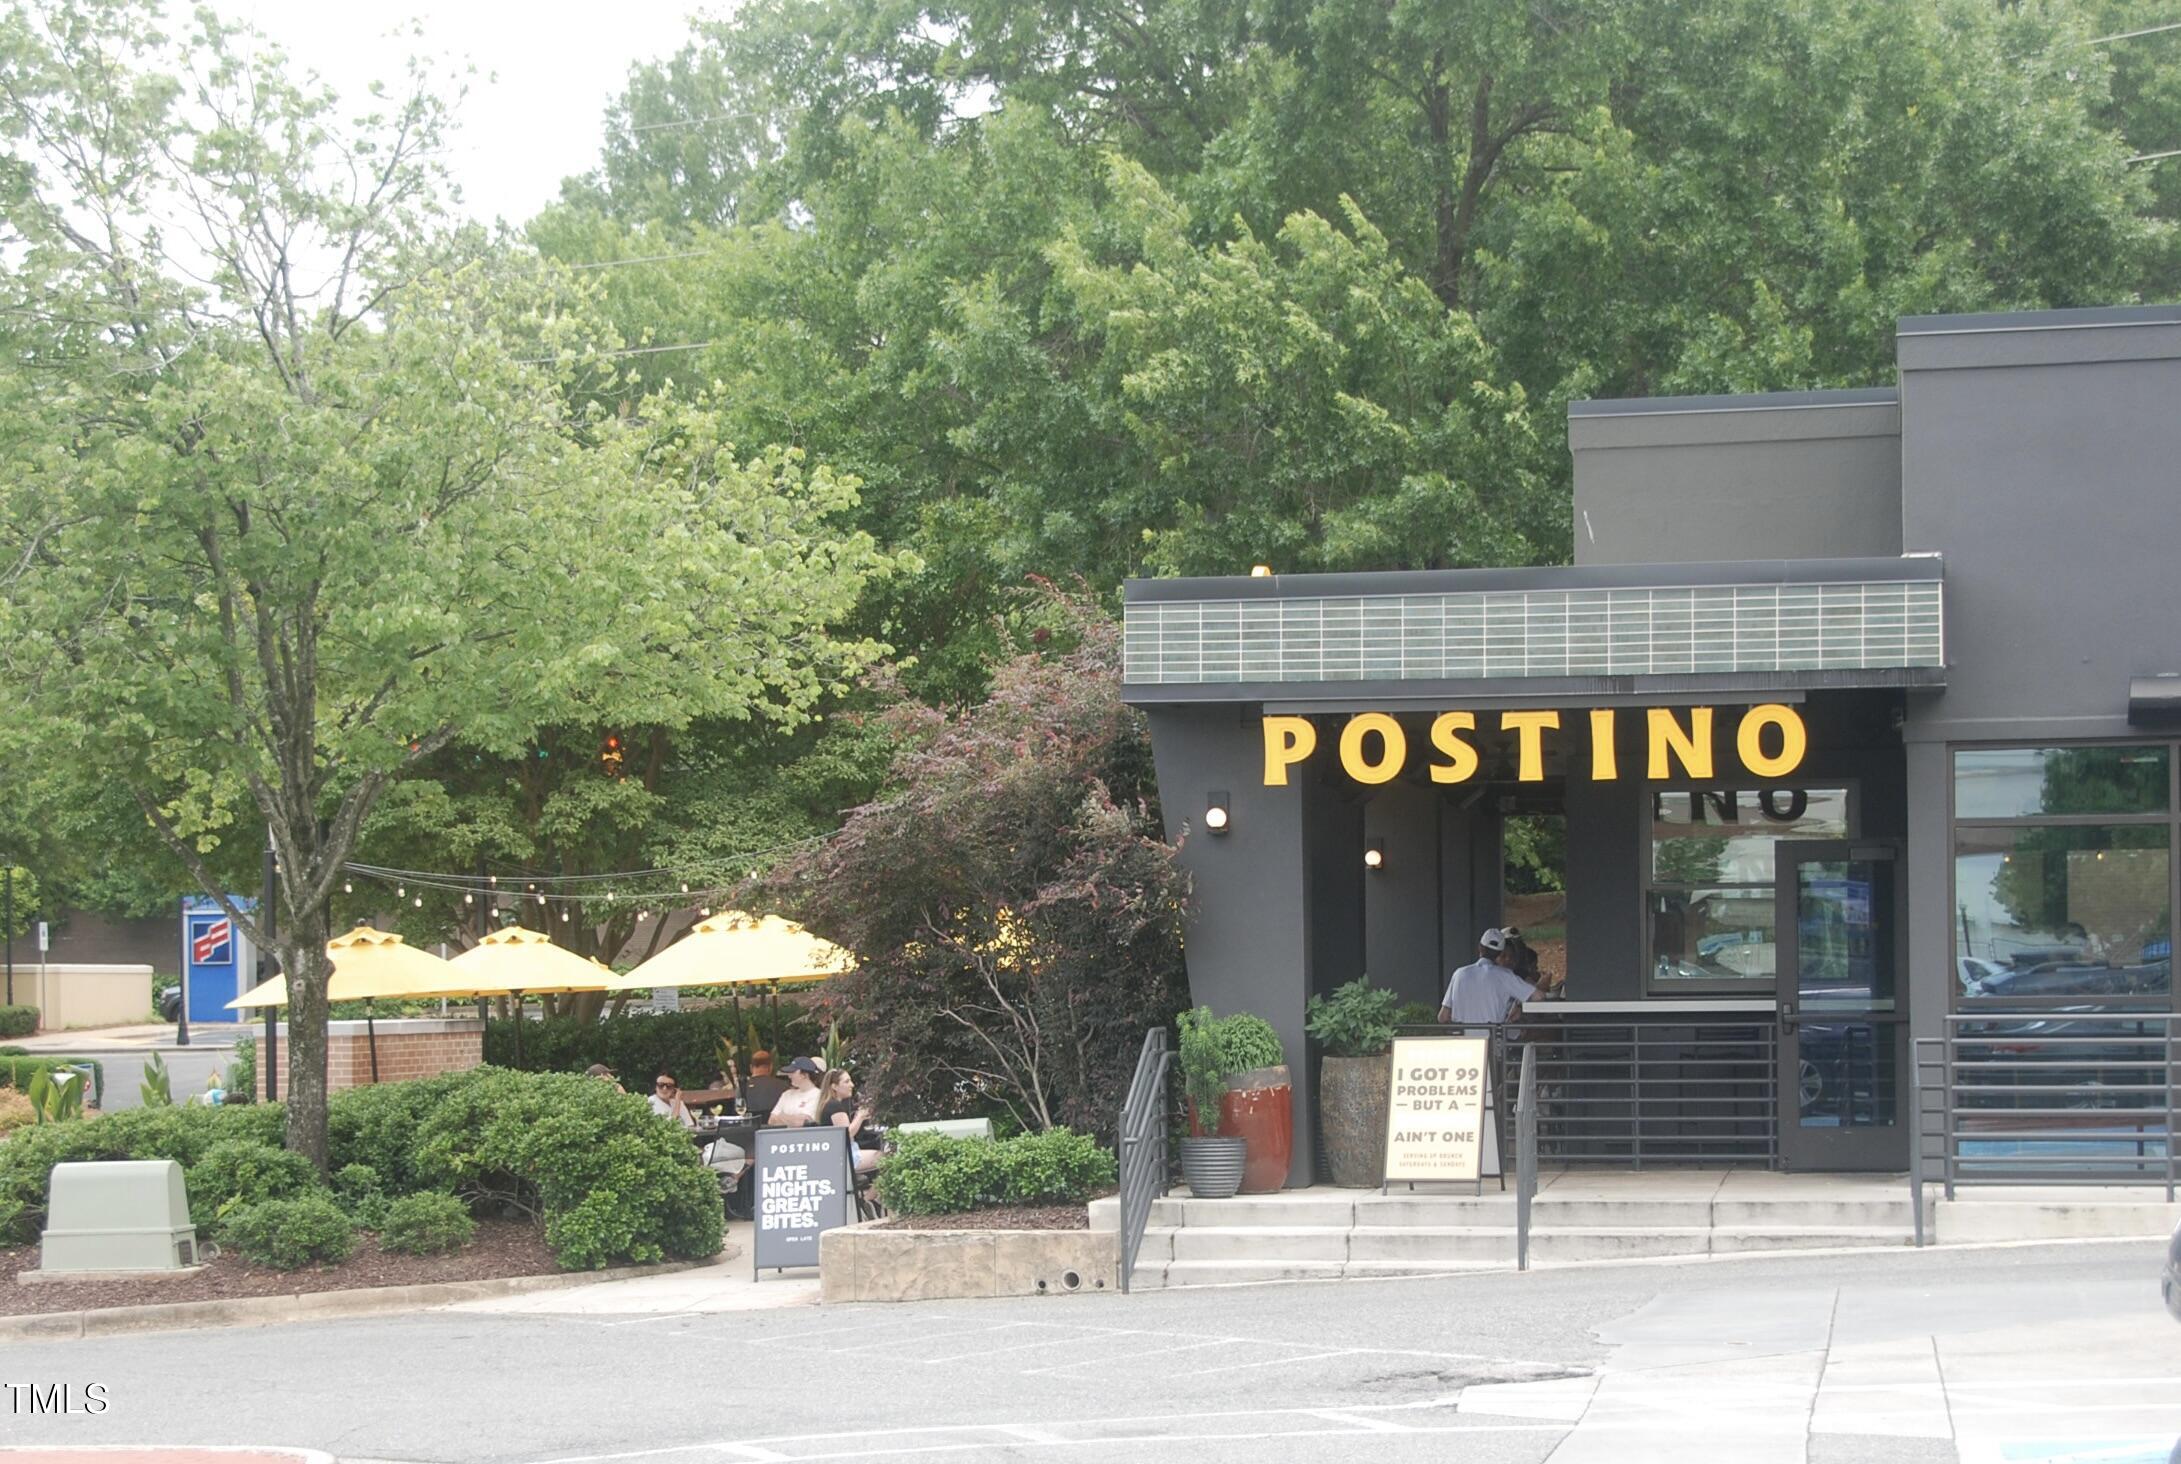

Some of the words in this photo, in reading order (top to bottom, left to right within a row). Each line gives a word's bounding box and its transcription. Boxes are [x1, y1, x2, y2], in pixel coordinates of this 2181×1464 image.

[1263, 704, 1806, 785] POSTINO
[1397, 1068, 1403, 1081] I
[1410, 1068, 1449, 1081] GOT
[1455, 1068, 1479, 1081] 99
[1397, 1085, 1478, 1096] PROBLEMS
[1413, 1100, 1443, 1111] BUT
[1448, 1100, 1459, 1111] A
[1394, 1131, 1437, 1142] AIN'T
[1442, 1131, 1474, 1142] ONE
[770, 1142, 830, 1154] POSTINO
[762, 1165, 808, 1183] LATE
[762, 1180, 836, 1198] NIGHTS.
[762, 1196, 822, 1214] GREAT
[762, 1213, 818, 1230] BITES.
